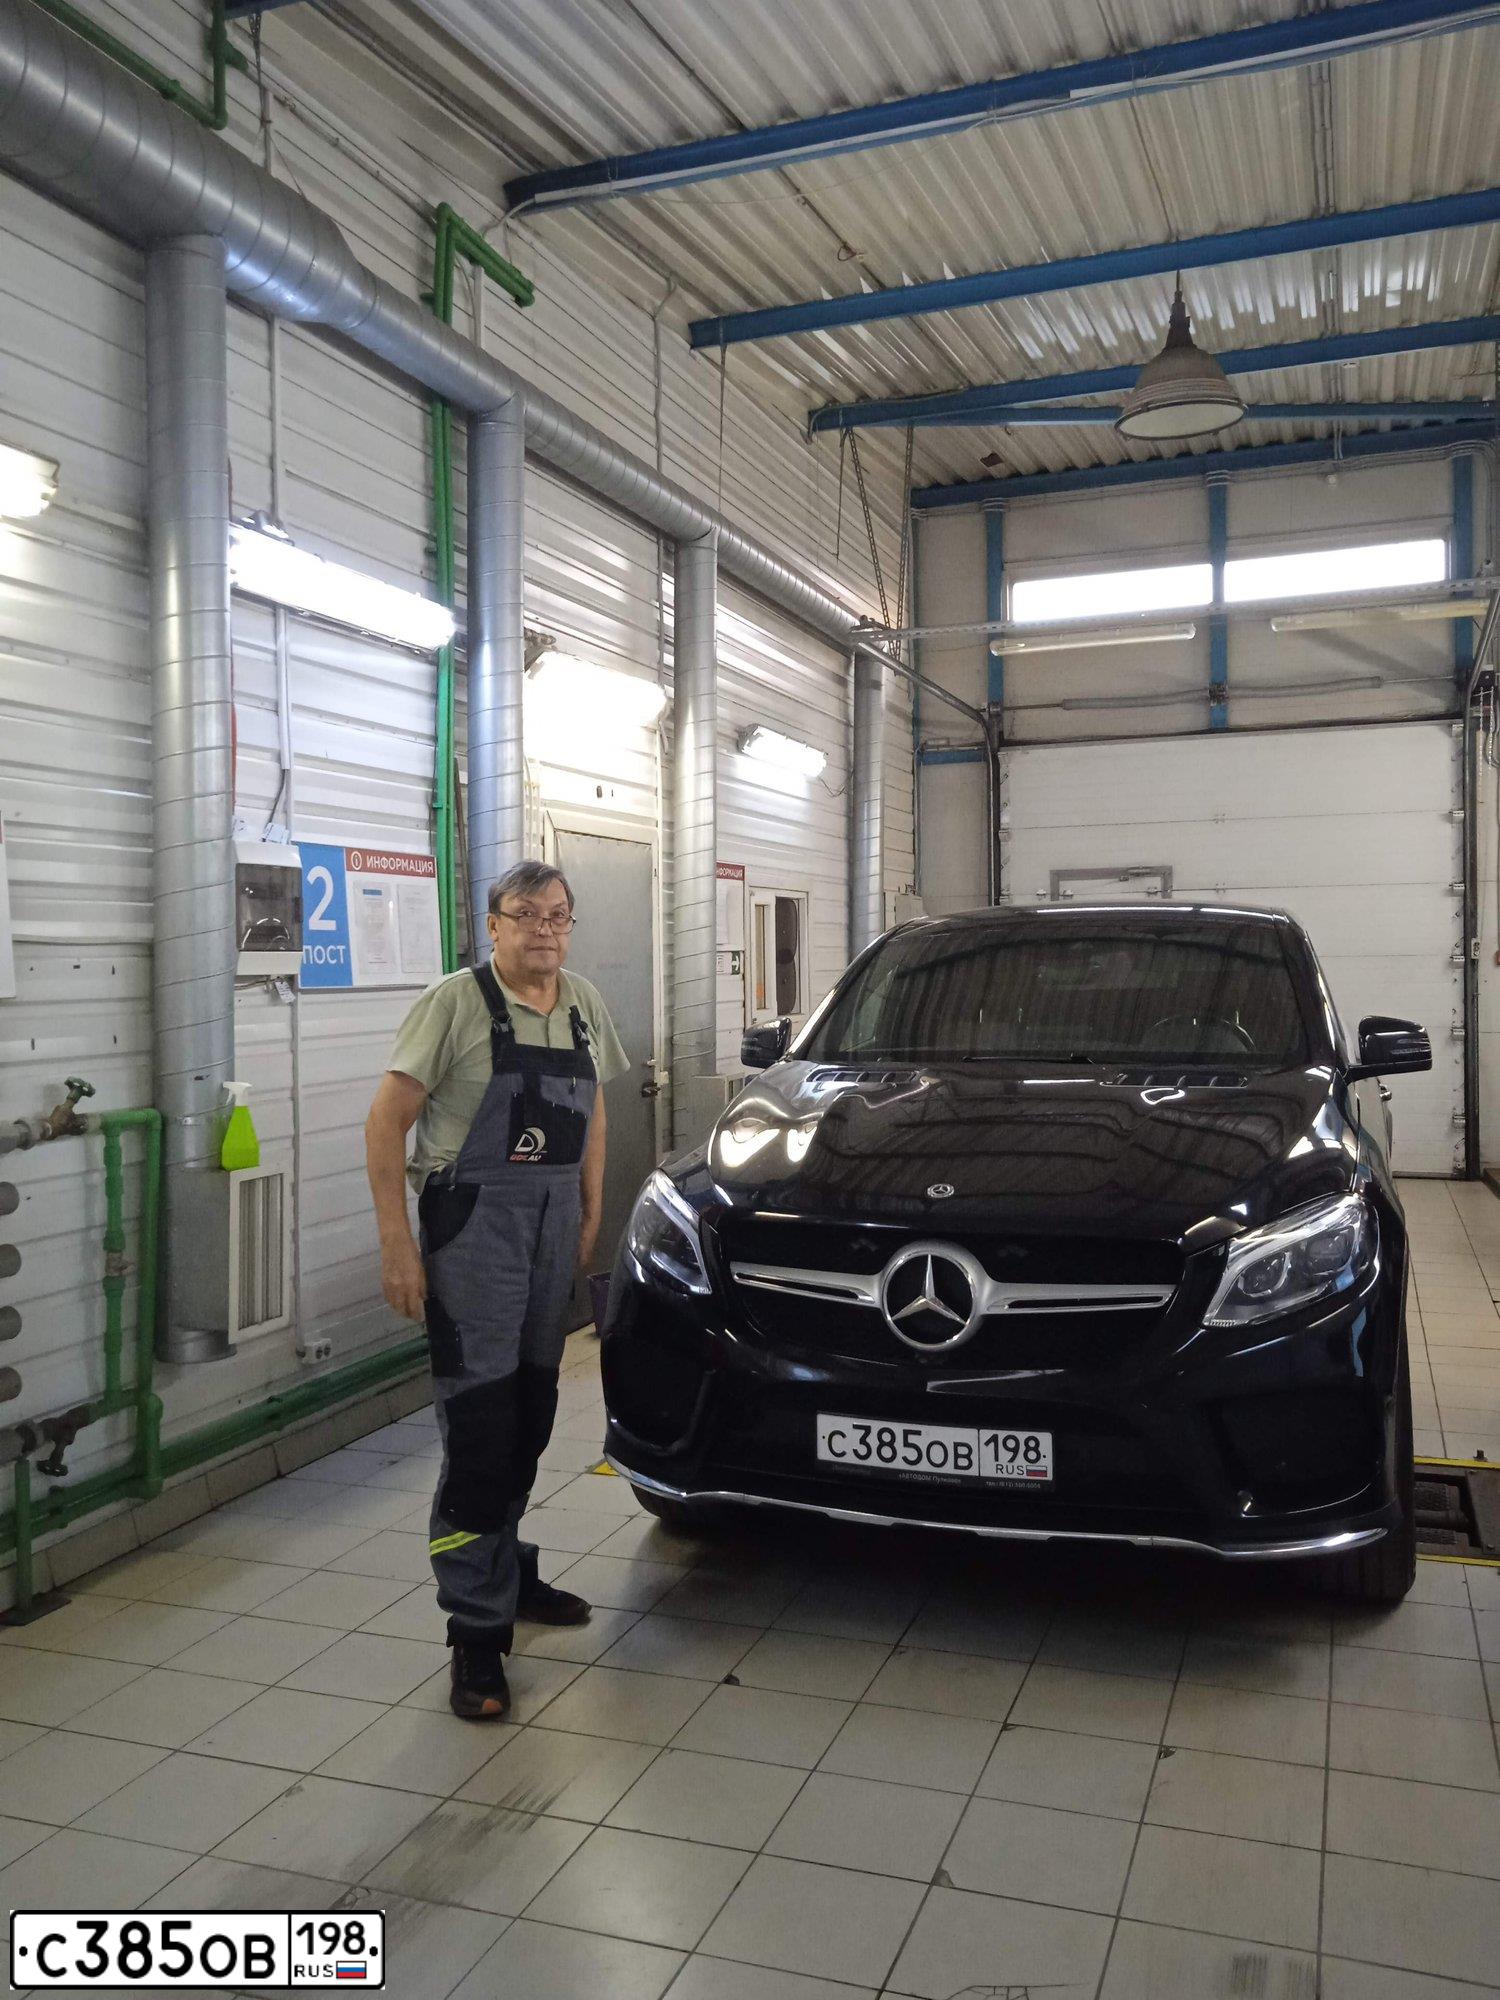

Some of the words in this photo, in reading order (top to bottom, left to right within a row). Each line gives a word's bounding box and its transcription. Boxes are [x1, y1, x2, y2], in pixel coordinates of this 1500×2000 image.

[366, 855, 434, 873] ИНФОРМАЦИЯ
[306, 865, 337, 931] 2
[302, 944, 346, 965] ПОСТ
[827, 1423, 974, 1471] С385ОВ
[983, 1433, 1041, 1464] 198
[995, 1463, 1025, 1476] RUS
